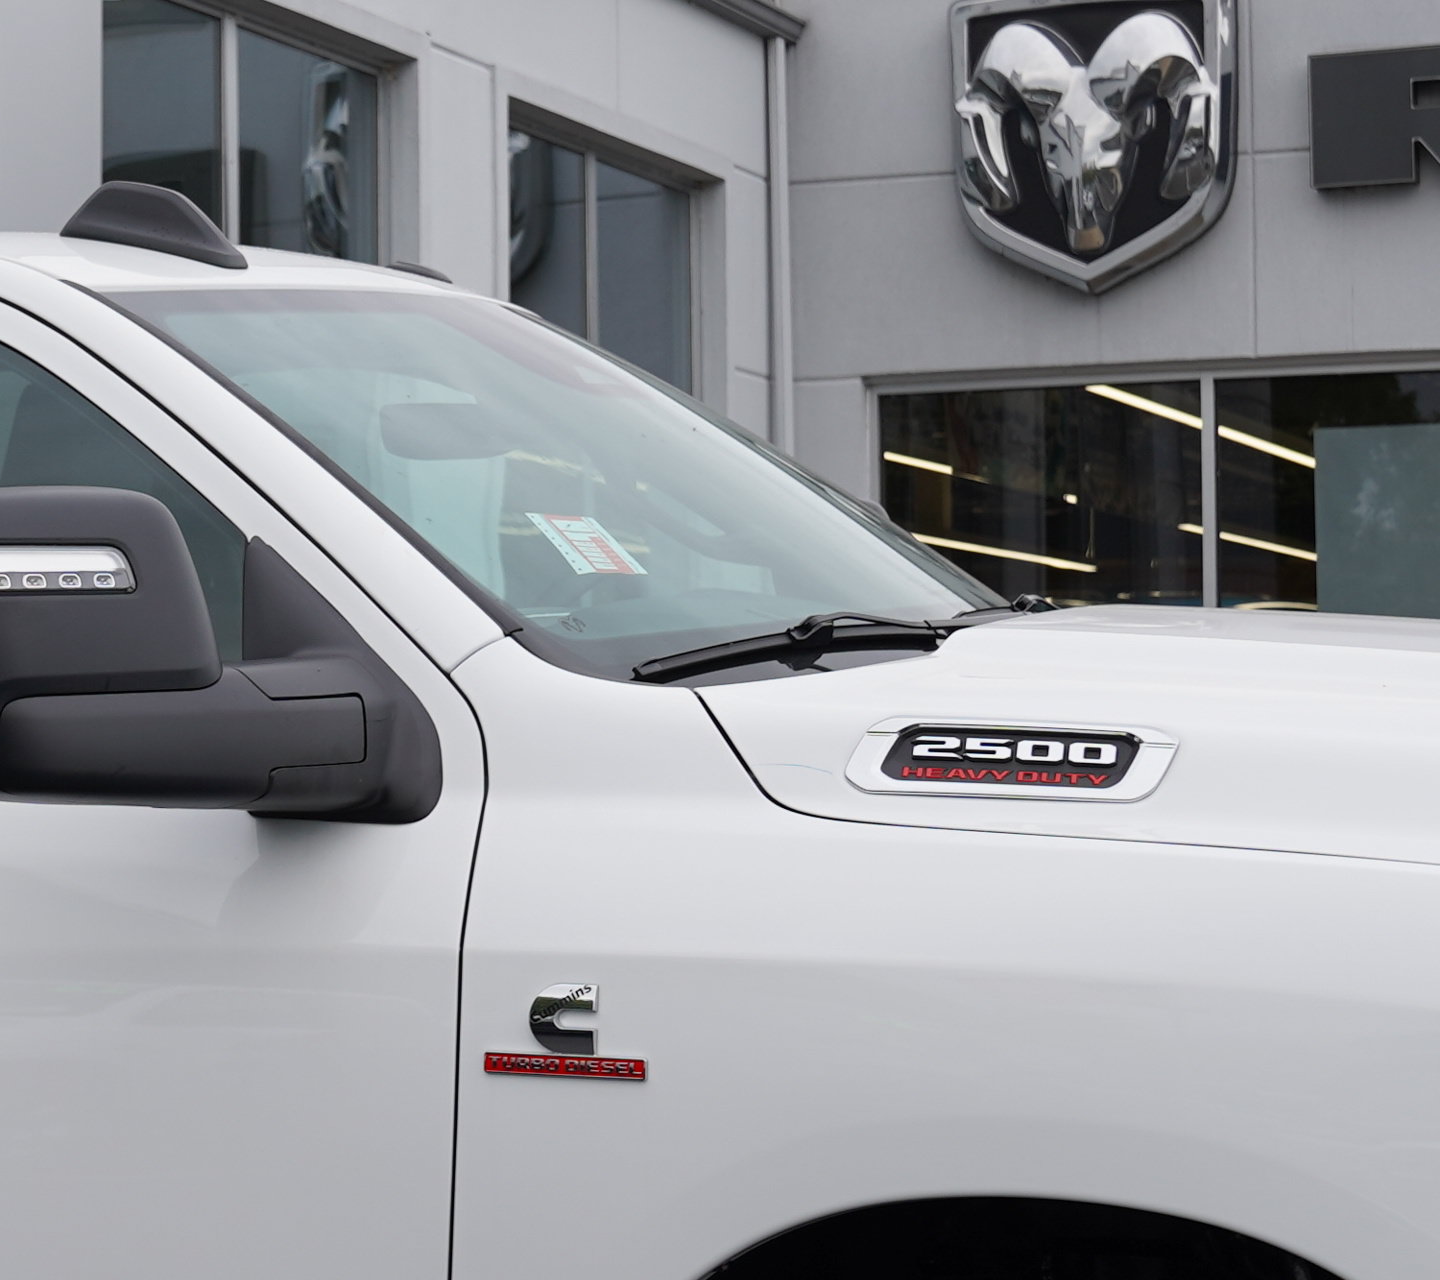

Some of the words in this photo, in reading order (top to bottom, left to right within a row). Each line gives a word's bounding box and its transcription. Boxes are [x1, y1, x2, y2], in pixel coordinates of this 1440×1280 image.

[911, 735, 1118, 766] 2500
[900, 766, 1013, 782] HEAVY
[1016, 770, 1109, 786] DUTY
[529, 983, 592, 1024] Cummins
[487, 1055, 560, 1072] TURBO
[565, 1059, 643, 1076] DIESEL
